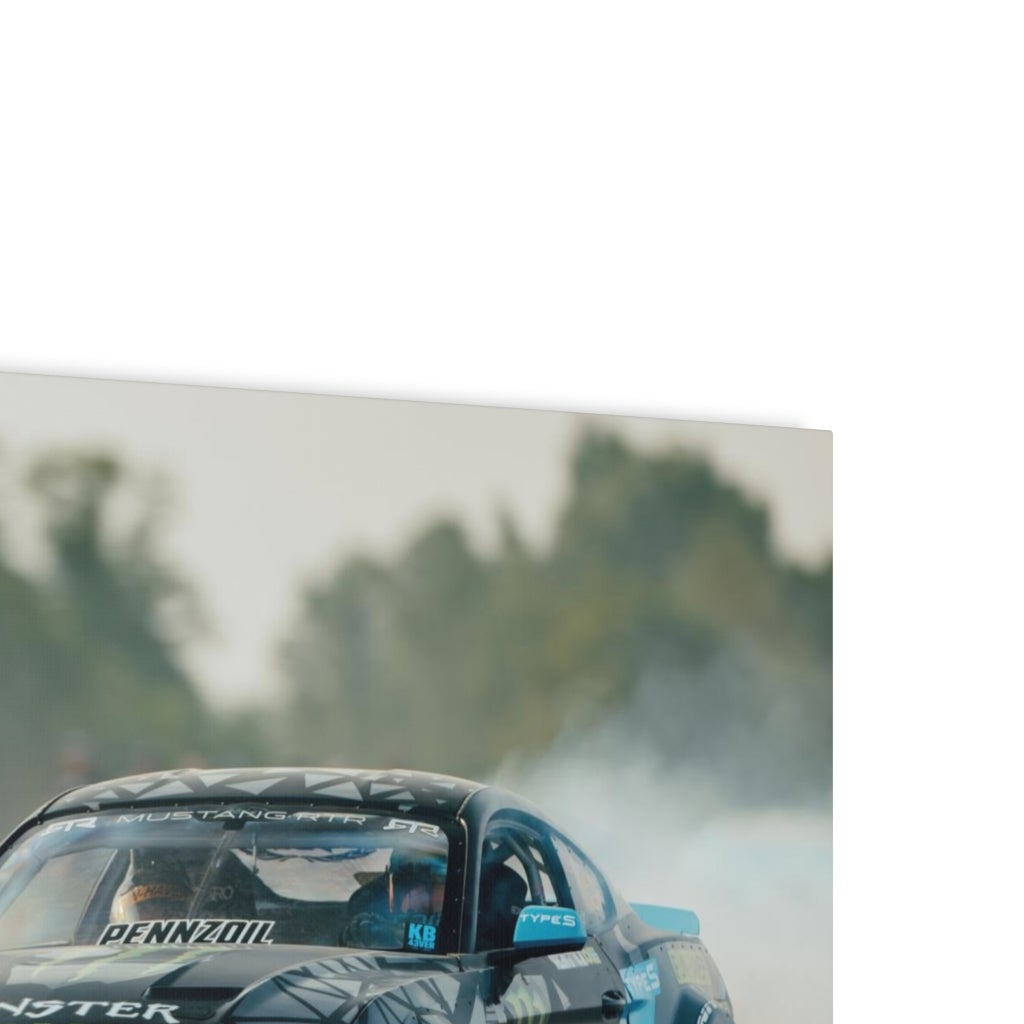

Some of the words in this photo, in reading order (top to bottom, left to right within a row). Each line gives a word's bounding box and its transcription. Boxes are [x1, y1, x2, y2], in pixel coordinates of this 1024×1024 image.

[116, 809, 288, 824] MUSTANG
[296, 811, 367, 826] RTR
[96, 918, 277, 946] PENNZOIL
[408, 922, 437, 942] KB
